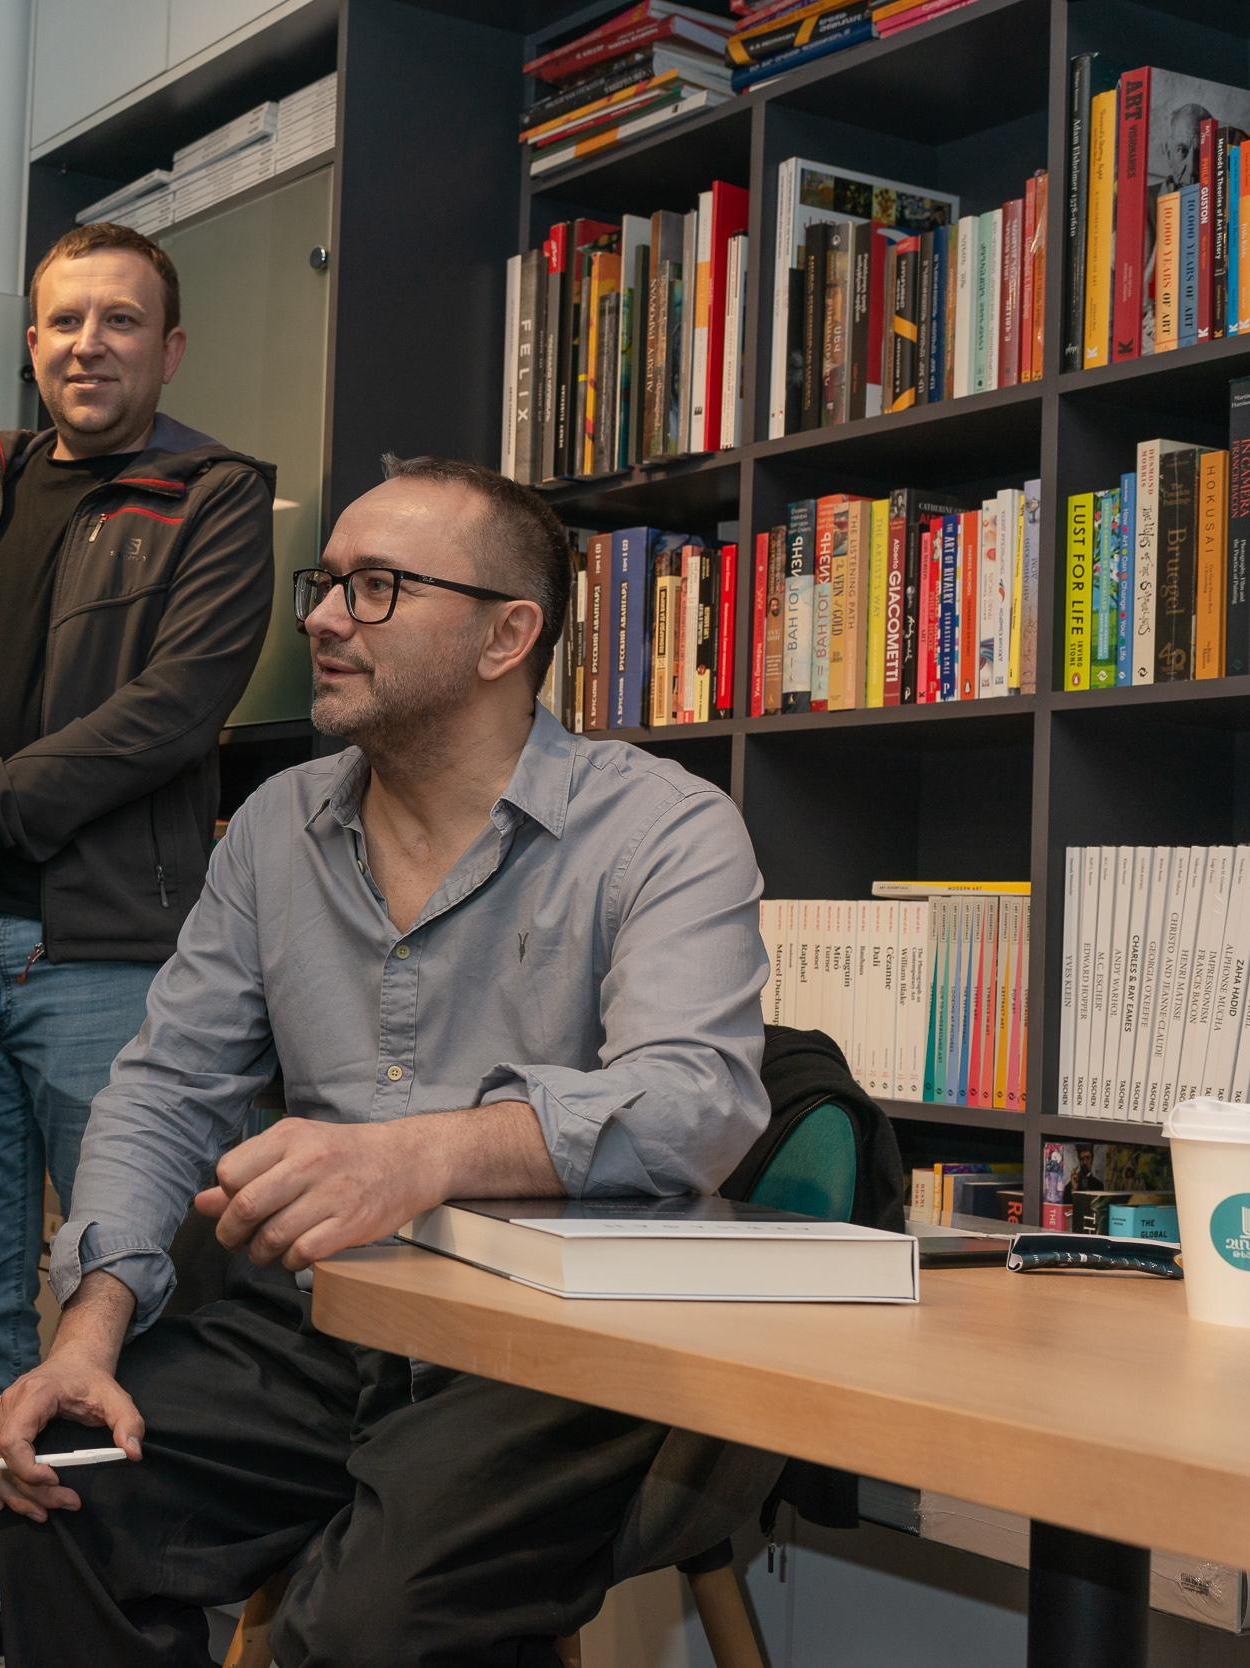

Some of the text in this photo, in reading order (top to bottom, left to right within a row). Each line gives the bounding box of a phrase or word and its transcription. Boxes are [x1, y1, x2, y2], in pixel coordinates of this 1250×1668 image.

[1125, 80, 1144, 121] ART
[1071, 119, 1081, 145] Adam
[1200, 186, 1209, 225] GUSTON
[1185, 199, 1196, 329] 10,000 YEARS OF ART
[1215, 232, 1223, 260] History
[1162, 207, 1173, 336] 10,000 YEARS OF ART
[517, 319, 531, 422] FELIX
[1240, 457, 1250, 517] CAMERA
[1205, 465, 1216, 553] HOKUSAI
[944, 536, 955, 552] ART
[848, 514, 858, 629] THE LISTENING PATH
[943, 567, 954, 604] RIVALRY
[1071, 504, 1086, 635] LUST FOR LIFE
[1160, 527, 1187, 616] Bruegel
[788, 586, 798, 611] ГОГ
[817, 591, 828, 619] ГОГ
[831, 574, 844, 636] VEIN GOLD
[885, 539, 901, 682] Alberto GIACOMETTI
[1120, 581, 1128, 611] Change
[618, 630, 626, 671] РУССКИЙ
[787, 617, 798, 651] ВАН
[815, 624, 827, 658] ВАН
[1167, 912, 1179, 953] CHRISTO
[800, 944, 808, 983] Raphael
[844, 946, 852, 987] Gauguin
[885, 947, 894, 990] Cézanne
[900, 948, 908, 981] William
[1097, 951, 1105, 971] M.C.
[1129, 935, 1140, 974] CHARLES
[1145, 941, 1157, 982] GEORGIA
[1164, 957, 1175, 978] AND
[1064, 955, 1073, 1007] YVES KLEIN
[1080, 942, 1091, 1020] EDWARD HOPPER
[1110, 949, 1122, 1018] ANDY WARHOL
[1128, 985, 1136, 1001] RAY
[1173, 949, 1189, 1021] HENRI MATISSE
[1189, 949, 1205, 1024] FRANCIS BACON
[1199, 951, 1217, 1024] IMPRESSIONISM
[1213, 944, 1234, 1032] ALPHONSE MUCHA
[1229, 959, 1245, 1017] ZAHA HADID
[1124, 1003, 1134, 1032] EAMES
[1090, 1077, 1098, 1107] TASCHEN
[1103, 1079, 1112, 1109] TASCHEN
[1118, 1080, 1126, 1110] TASCHEN
[1132, 1081, 1141, 1111] TASCHEN
[1149, 1082, 1158, 1112] TASCHEN
[1162, 1083, 1172, 1112] TASCHEN
[1140, 1231, 1167, 1239] GLOBAL
[1141, 1219, 1155, 1227] THE
